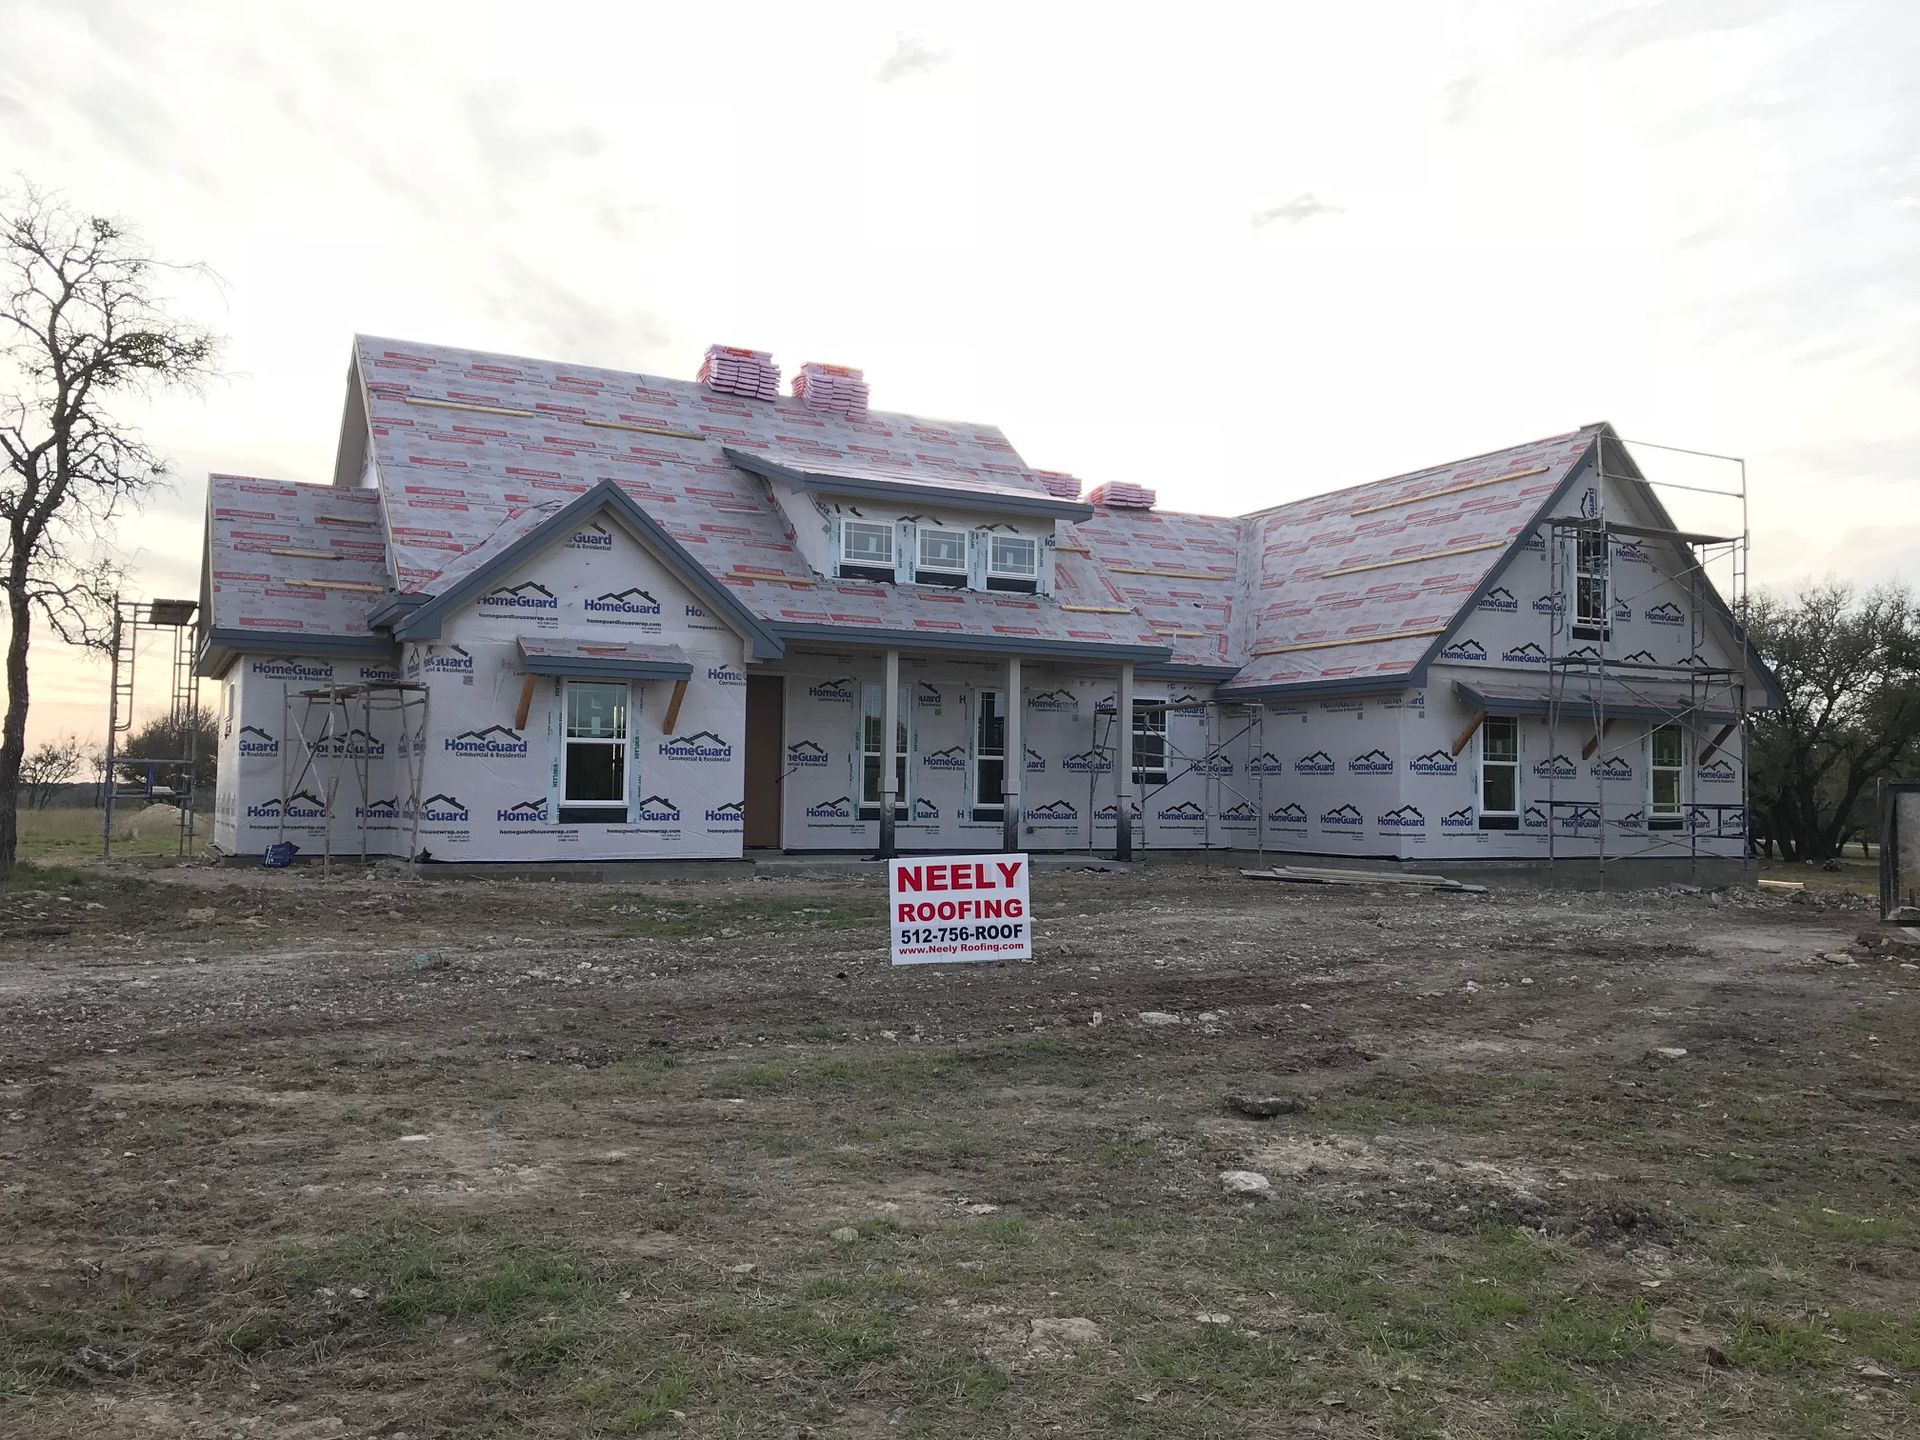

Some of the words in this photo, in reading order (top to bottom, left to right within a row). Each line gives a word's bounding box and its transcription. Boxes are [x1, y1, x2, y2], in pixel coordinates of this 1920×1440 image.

[567, 532, 613, 545] Guard
[584, 599, 661, 614] HomeGuard
[1478, 599, 1518, 609] omeGuard
[1441, 649, 1487, 661] HomeGuard
[1502, 652, 1547, 663] HomeGuard
[252, 662, 334, 677] HomeGuard
[809, 687, 852, 698] HomeGu
[239, 740, 279, 752] Guard
[445, 738, 528, 753] HomeGuard
[659, 744, 731, 758] HomeGuard
[1295, 762, 1335, 771] HomeGuard
[1349, 761, 1393, 771] HomeGuard
[1410, 761, 1458, 772] HomeGuard
[1698, 770, 1736, 779] HomeGuard
[427, 809, 469, 822] Guard
[497, 810, 548, 822] HomeG
[639, 809, 680, 822] Guard
[806, 807, 850, 817] HomeGu
[1027, 811, 1078, 820] HomeGuard
[1158, 812, 1205, 821] HomeGuard
[1269, 813, 1308, 823] HomeGuard
[1320, 814, 1363, 825] HomeGuard
[1378, 816, 1425, 827] HomeGuard
[897, 862, 1022, 892] NEELY
[898, 899, 1023, 923] ROOFING
[901, 924, 1023, 944] 512-756-ROOF
[899, 945, 958, 954] www.Neely
[960, 943, 1024, 952] Roofing.com
